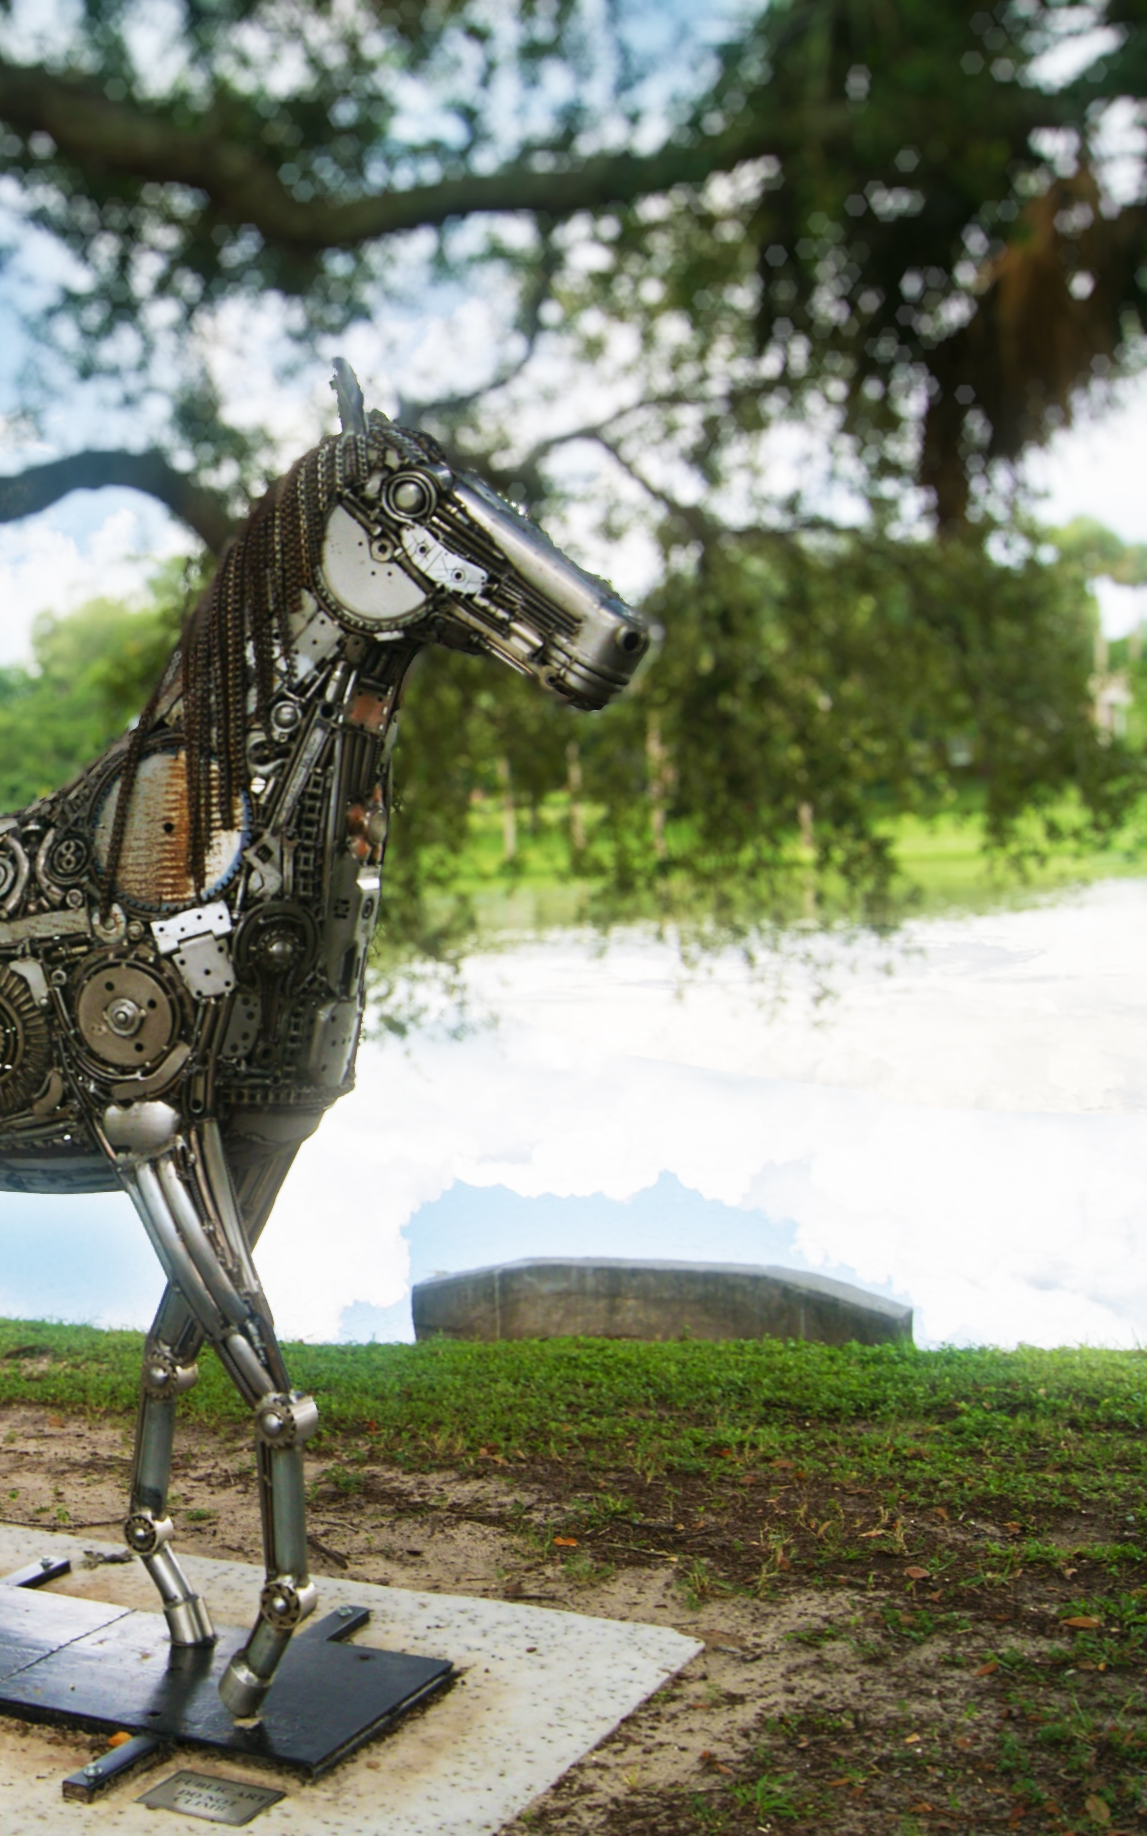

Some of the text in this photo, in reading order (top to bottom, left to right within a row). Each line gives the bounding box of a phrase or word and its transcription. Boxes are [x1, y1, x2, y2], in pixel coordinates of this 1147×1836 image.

[174, 1777, 267, 1803] PUBLIC ART
[178, 1788, 239, 1807] DO NOT
[173, 1796, 228, 1812] CLIMB
